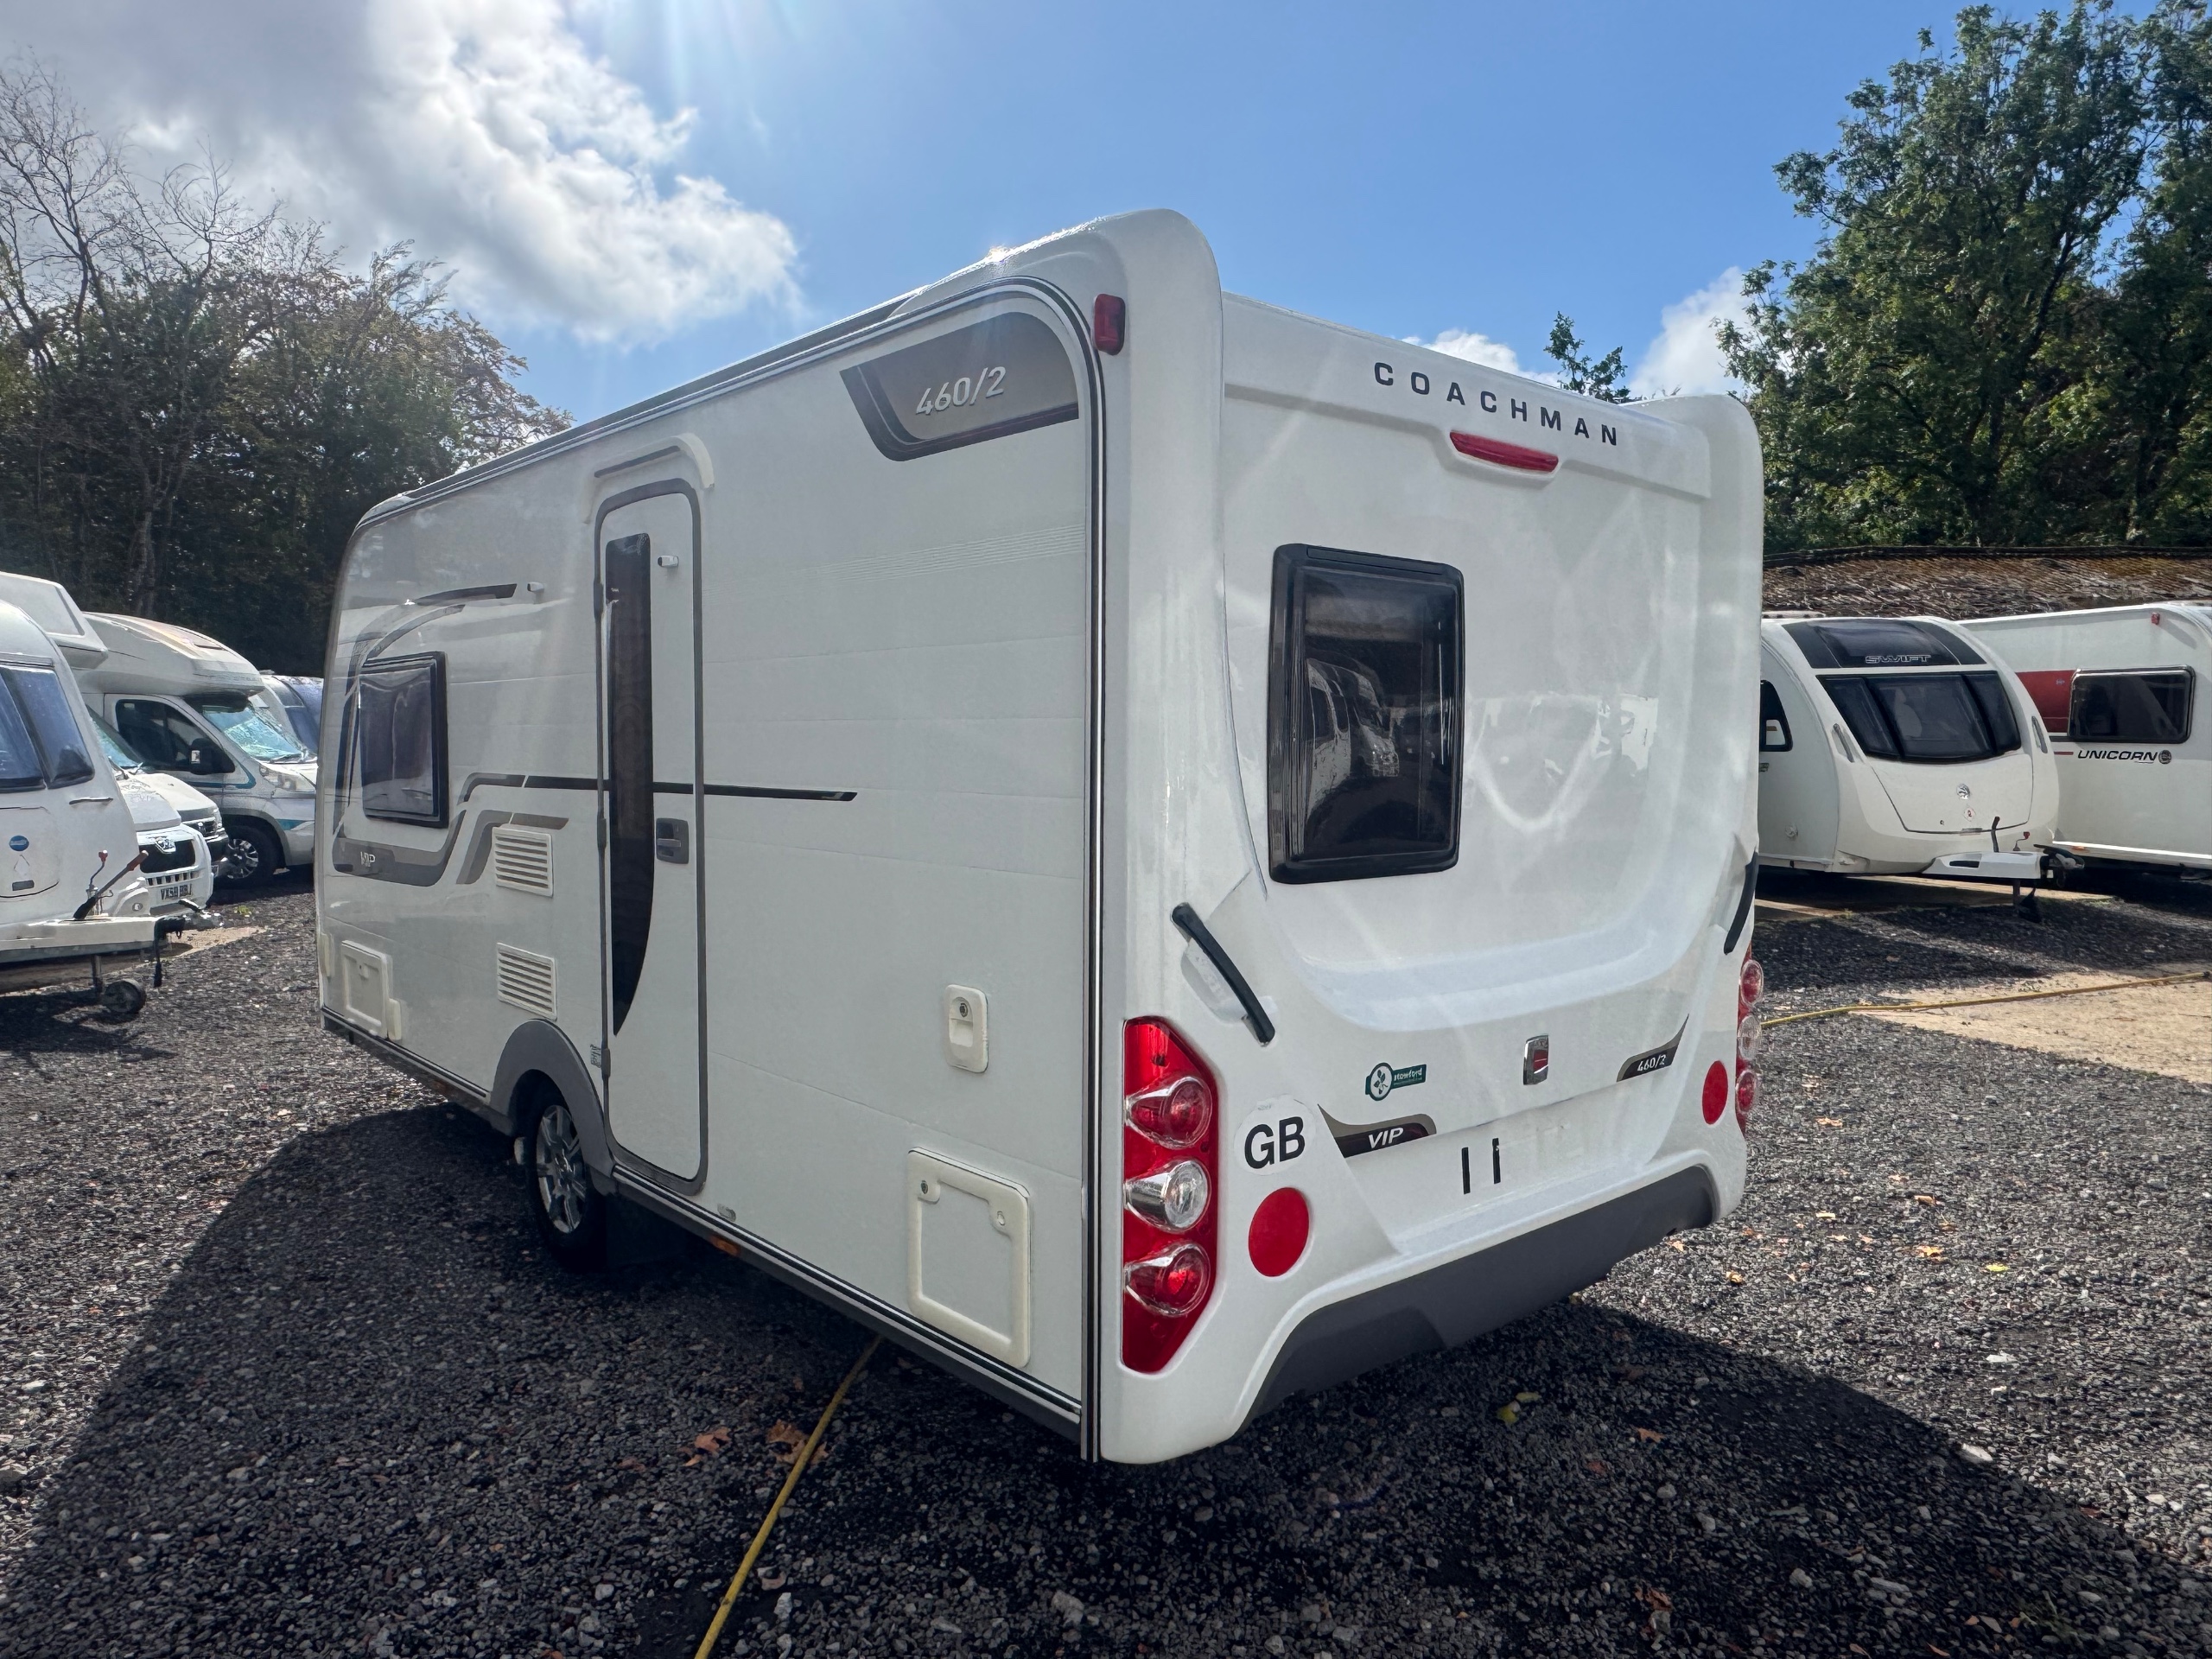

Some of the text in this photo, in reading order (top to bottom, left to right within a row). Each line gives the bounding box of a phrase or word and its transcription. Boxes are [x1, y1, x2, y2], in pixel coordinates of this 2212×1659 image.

[915, 365, 1007, 416] 460/2
[1374, 362, 1618, 446] COACHMAN
[1865, 654, 1932, 664] SWIFT
[2077, 750, 2158, 761] UNICORN
[1637, 1054, 1667, 1071] 460/2
[1244, 1116, 1306, 1169] GB
[1368, 1127, 1404, 1149] VIP
